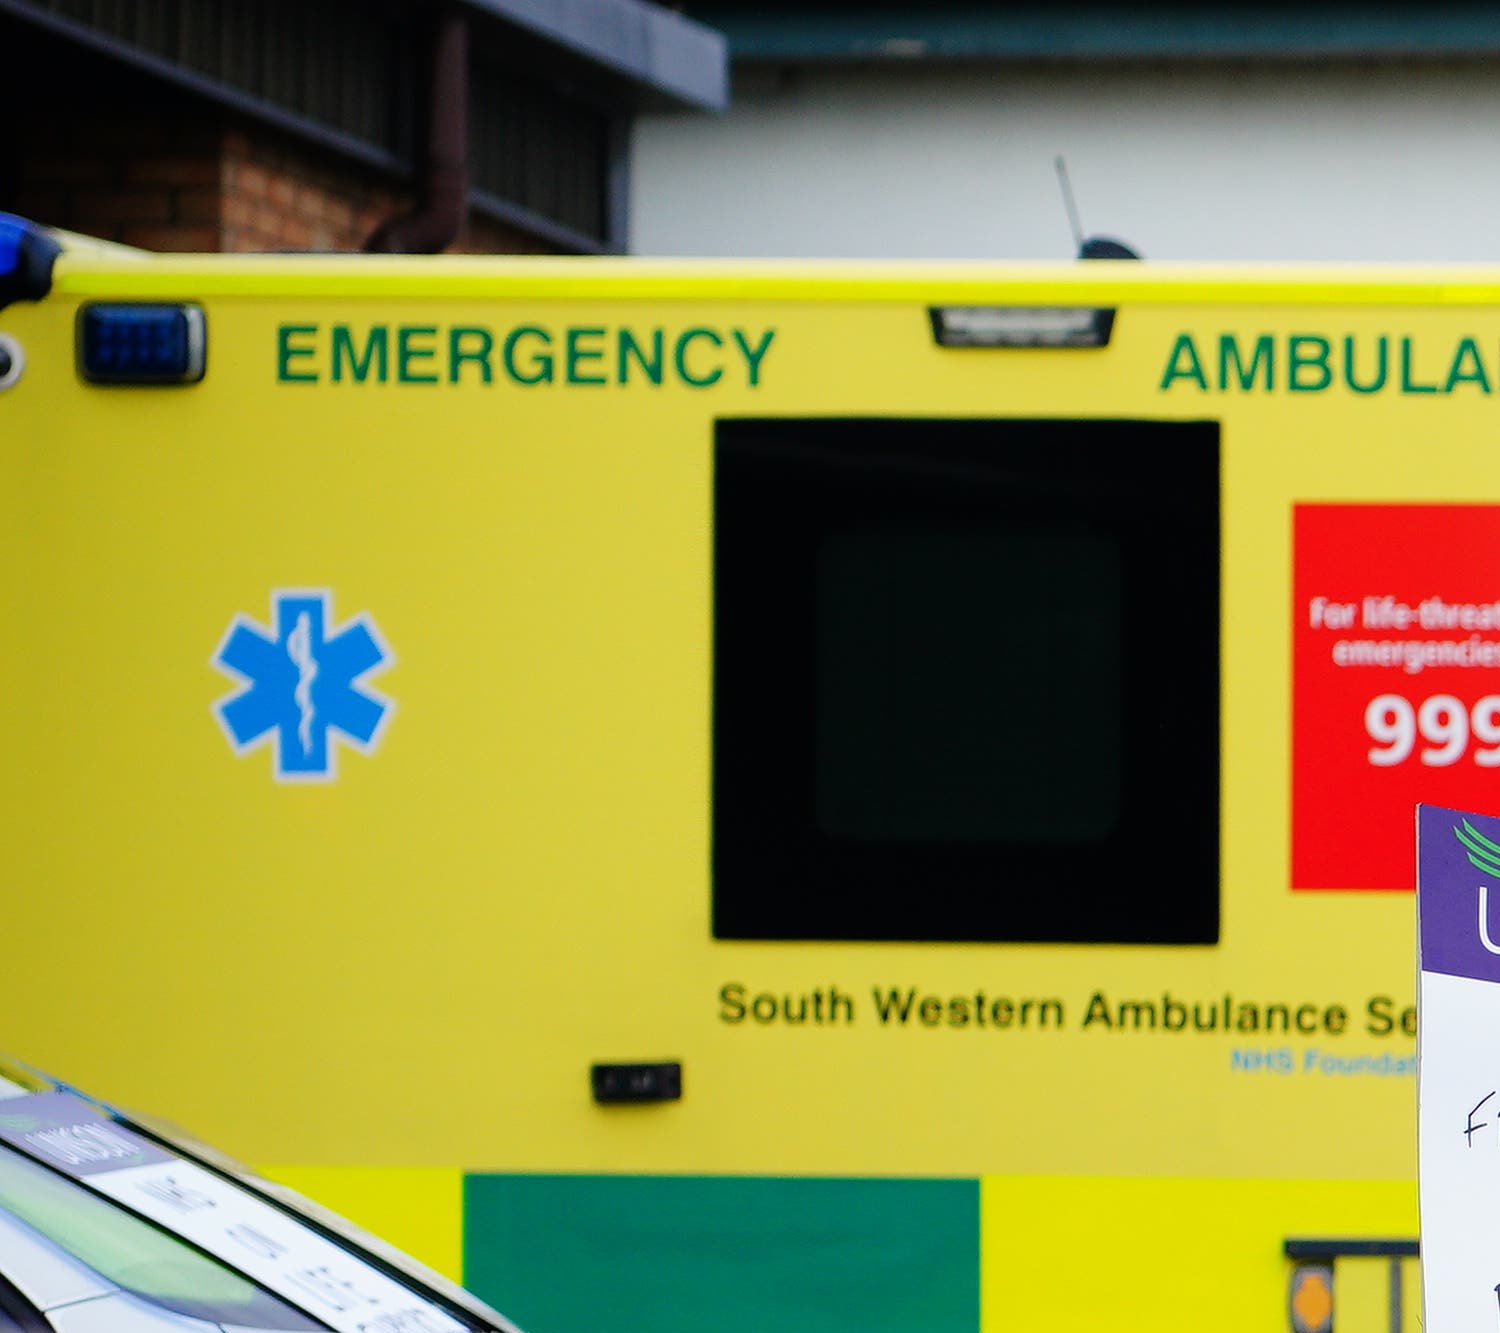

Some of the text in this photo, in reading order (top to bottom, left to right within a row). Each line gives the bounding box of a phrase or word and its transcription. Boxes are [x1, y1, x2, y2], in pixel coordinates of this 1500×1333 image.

[277, 322, 776, 388] EMERGENCY
[1309, 596, 1357, 630] For
[716, 984, 855, 1028] South
[873, 986, 1064, 1032] Western
[1082, 991, 1348, 1036] Ambulance
[1231, 1047, 1295, 1075] NHS
